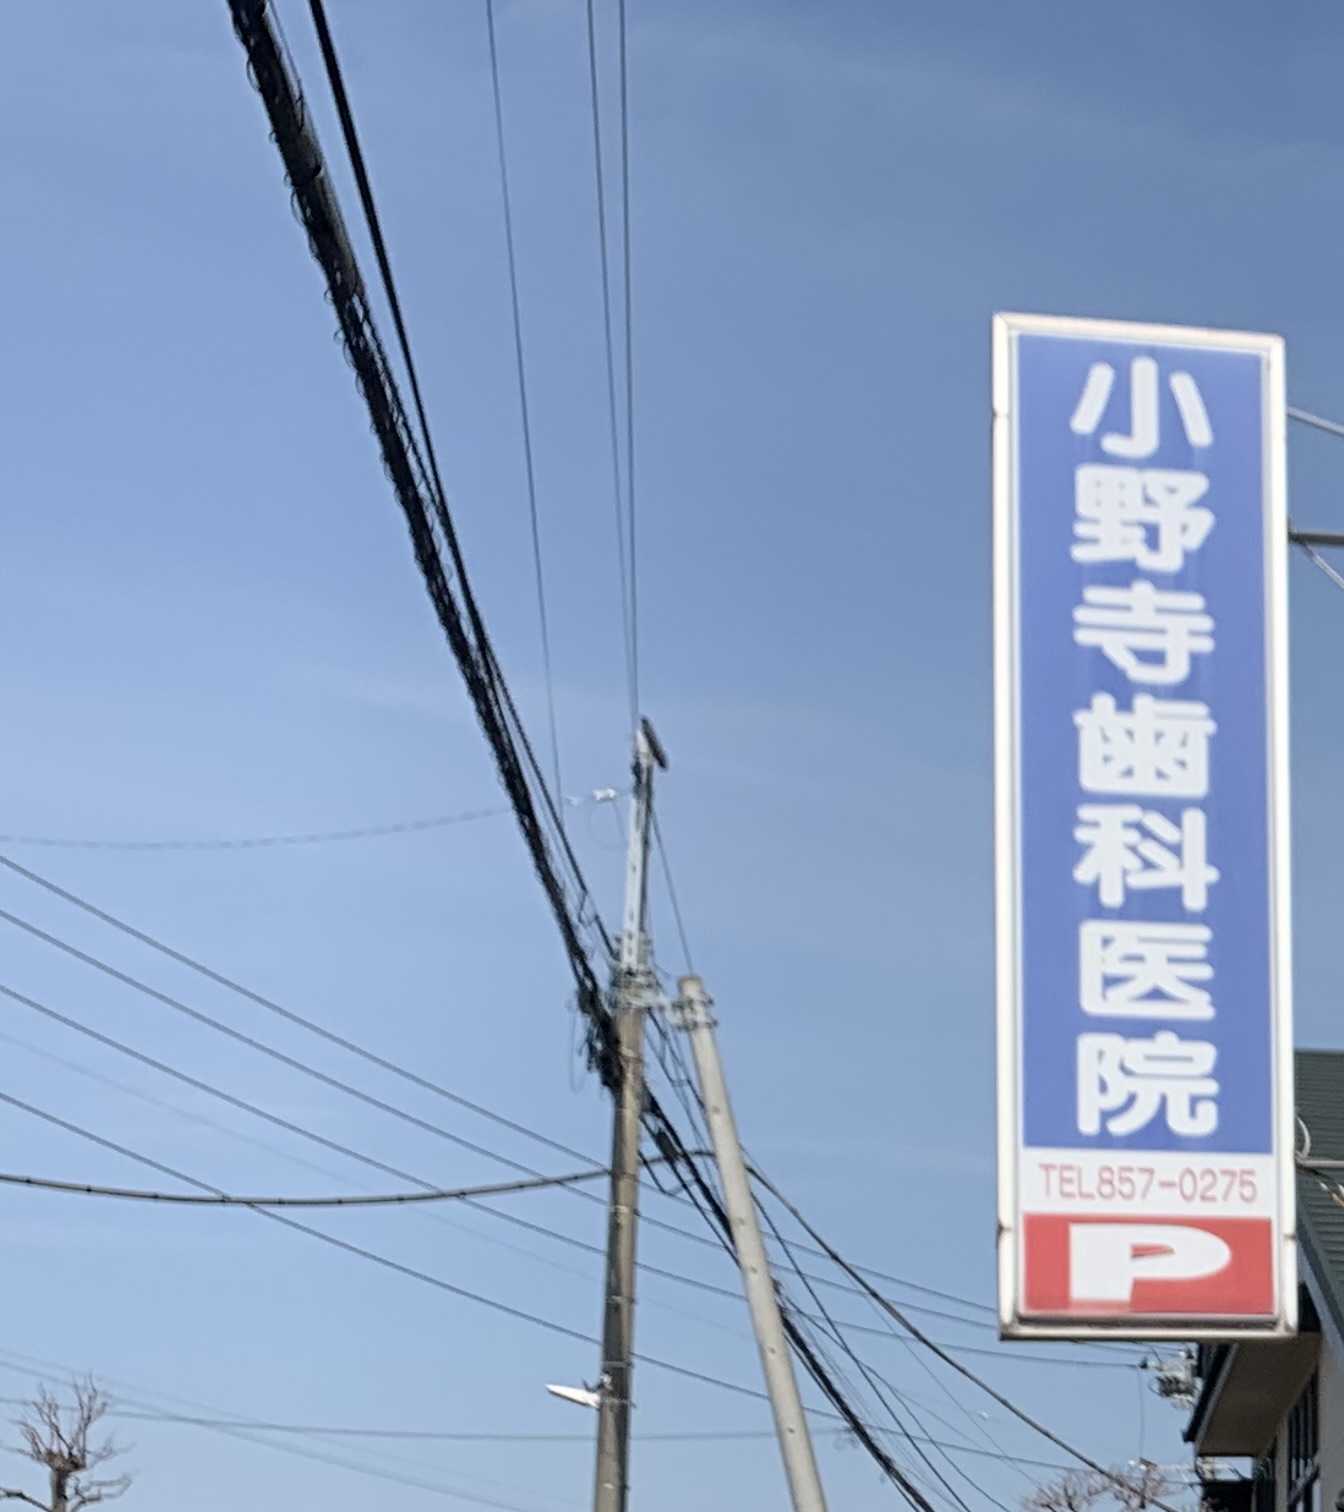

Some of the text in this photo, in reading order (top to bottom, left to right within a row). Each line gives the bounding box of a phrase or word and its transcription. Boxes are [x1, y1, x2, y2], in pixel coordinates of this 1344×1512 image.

[1069, 356, 1221, 1138] 小野寺歯科医院
[1069, 1222, 1232, 1301] P
